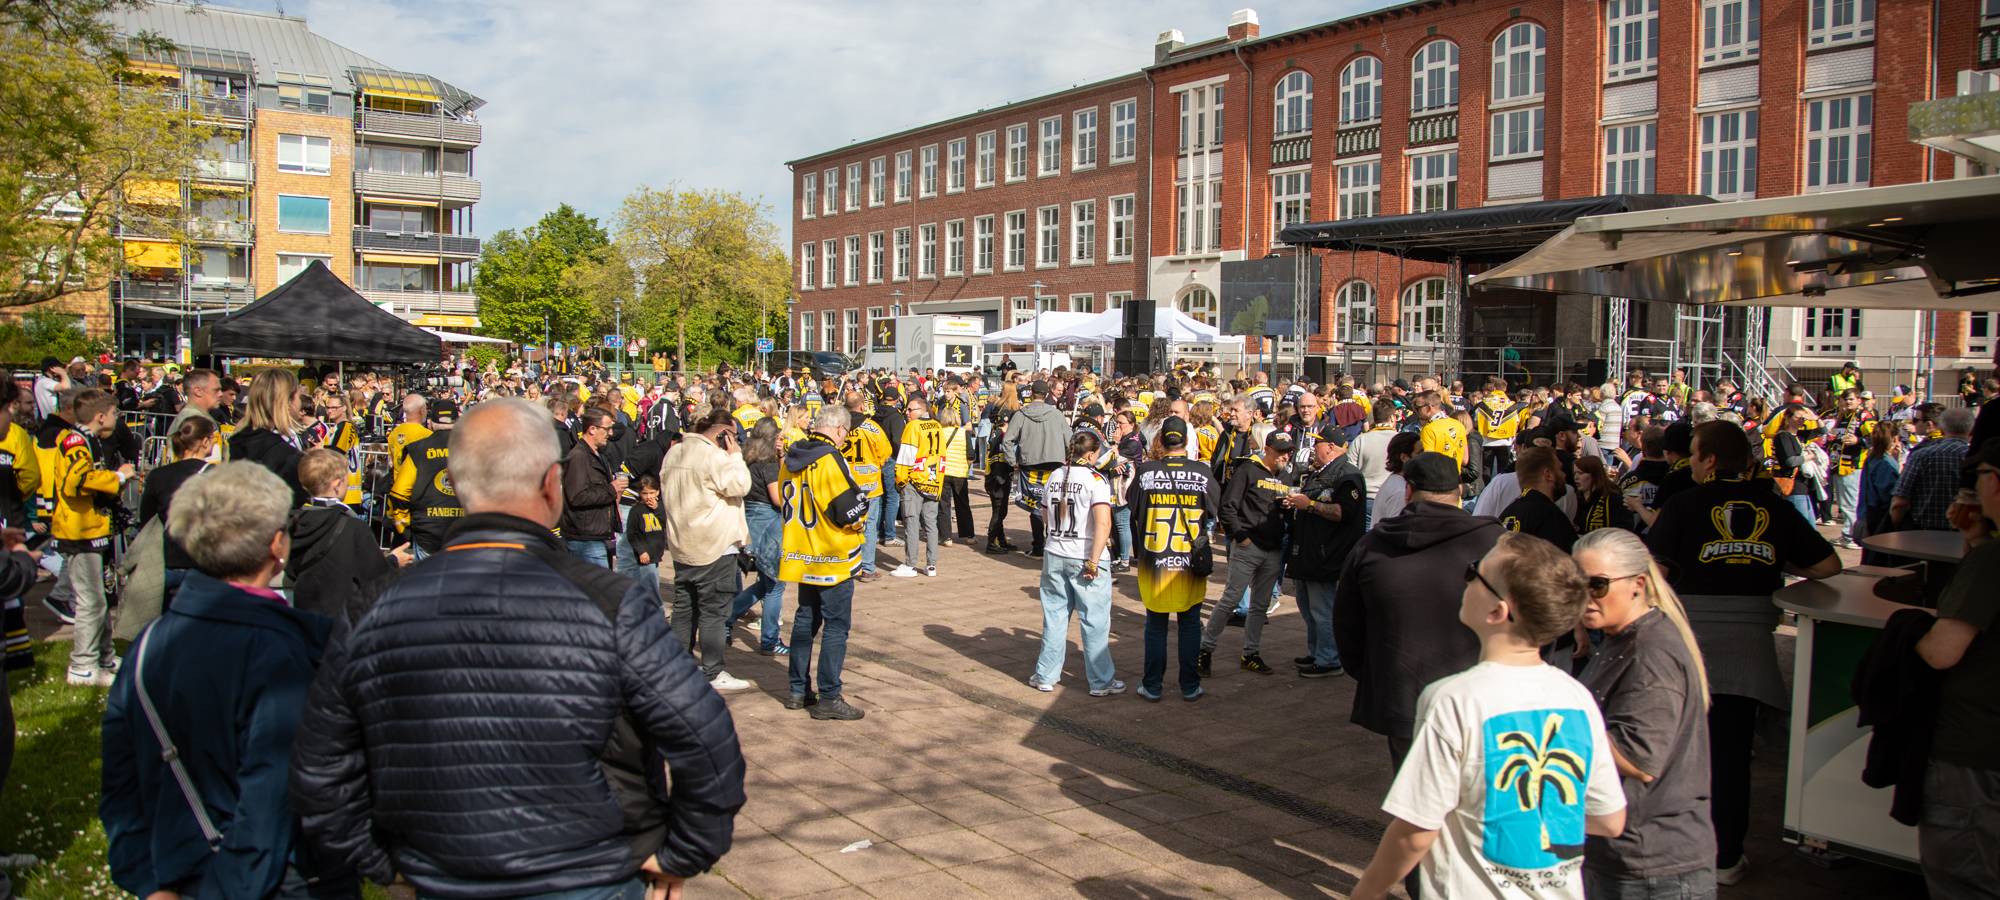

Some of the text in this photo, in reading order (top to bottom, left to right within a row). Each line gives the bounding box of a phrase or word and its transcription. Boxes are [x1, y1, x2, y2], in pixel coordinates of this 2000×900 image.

[927, 431, 940, 455] 11
[782, 480, 818, 530] 80
[846, 502, 866, 519] RWE
[1050, 497, 1078, 538] 11
[1144, 507, 1204, 553] 55
[91, 536, 109, 548] WIR
[1702, 542, 1774, 560] MEISTER
[1538, 870, 1554, 879] TO
